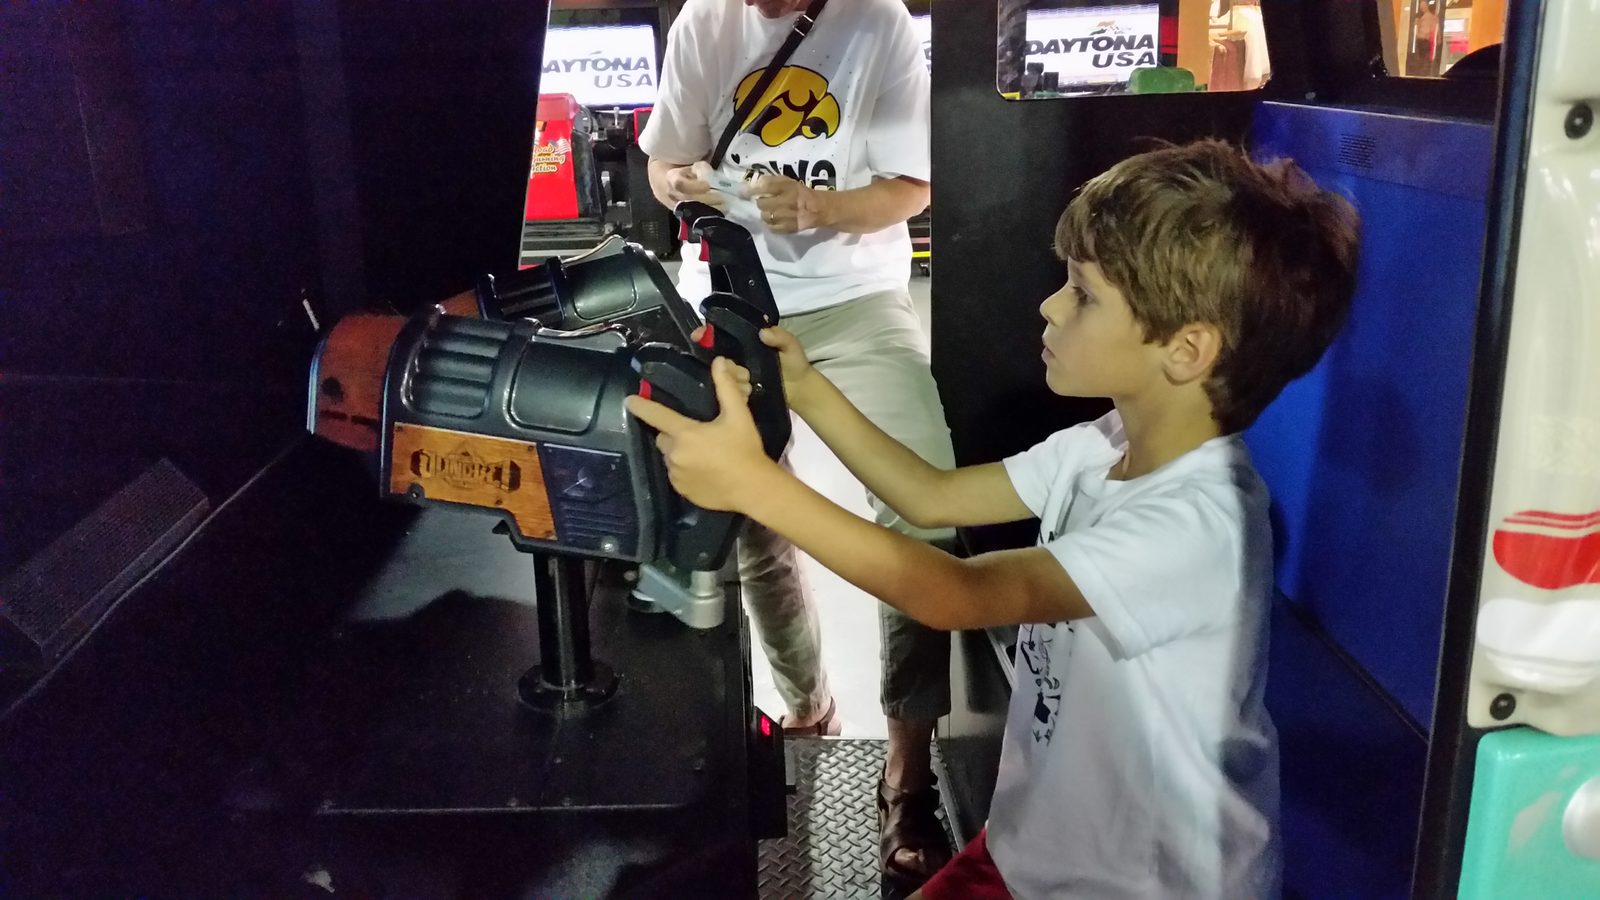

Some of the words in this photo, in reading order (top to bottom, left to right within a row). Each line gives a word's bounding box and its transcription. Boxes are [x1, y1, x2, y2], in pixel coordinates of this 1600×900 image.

[1024, 34, 1155, 56] DAYTONA
[1092, 51, 1156, 69] USA
[593, 73, 654, 89] USA
